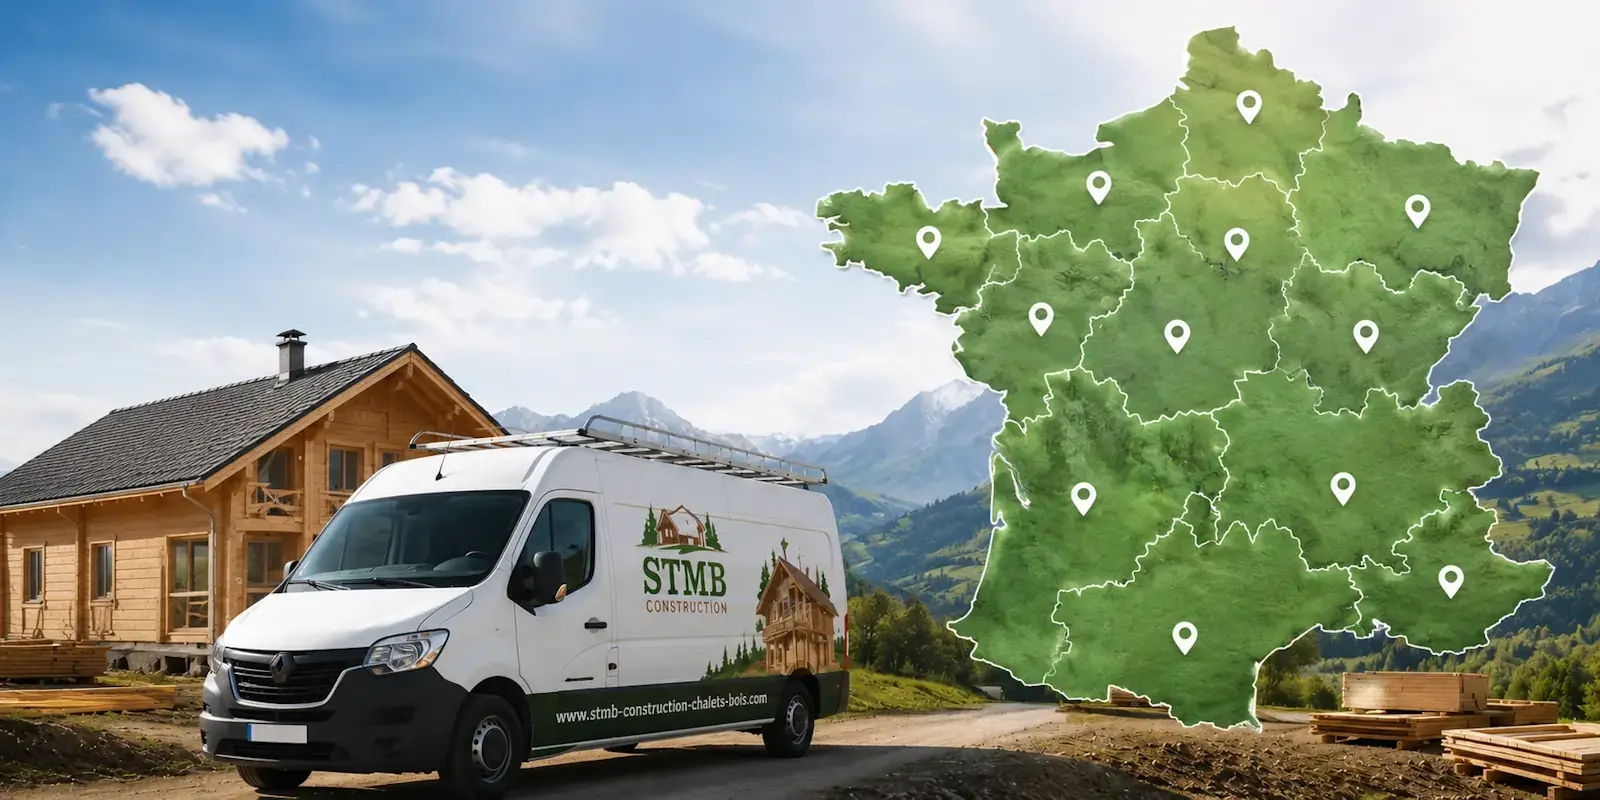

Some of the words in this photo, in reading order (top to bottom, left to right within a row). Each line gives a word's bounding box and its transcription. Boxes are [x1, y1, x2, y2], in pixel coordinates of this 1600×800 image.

[643, 556, 727, 597] STMB
[646, 599, 727, 614] CONSTRUCTION
[556, 692, 768, 723] www.stmb-construction-chalets-bois.com
